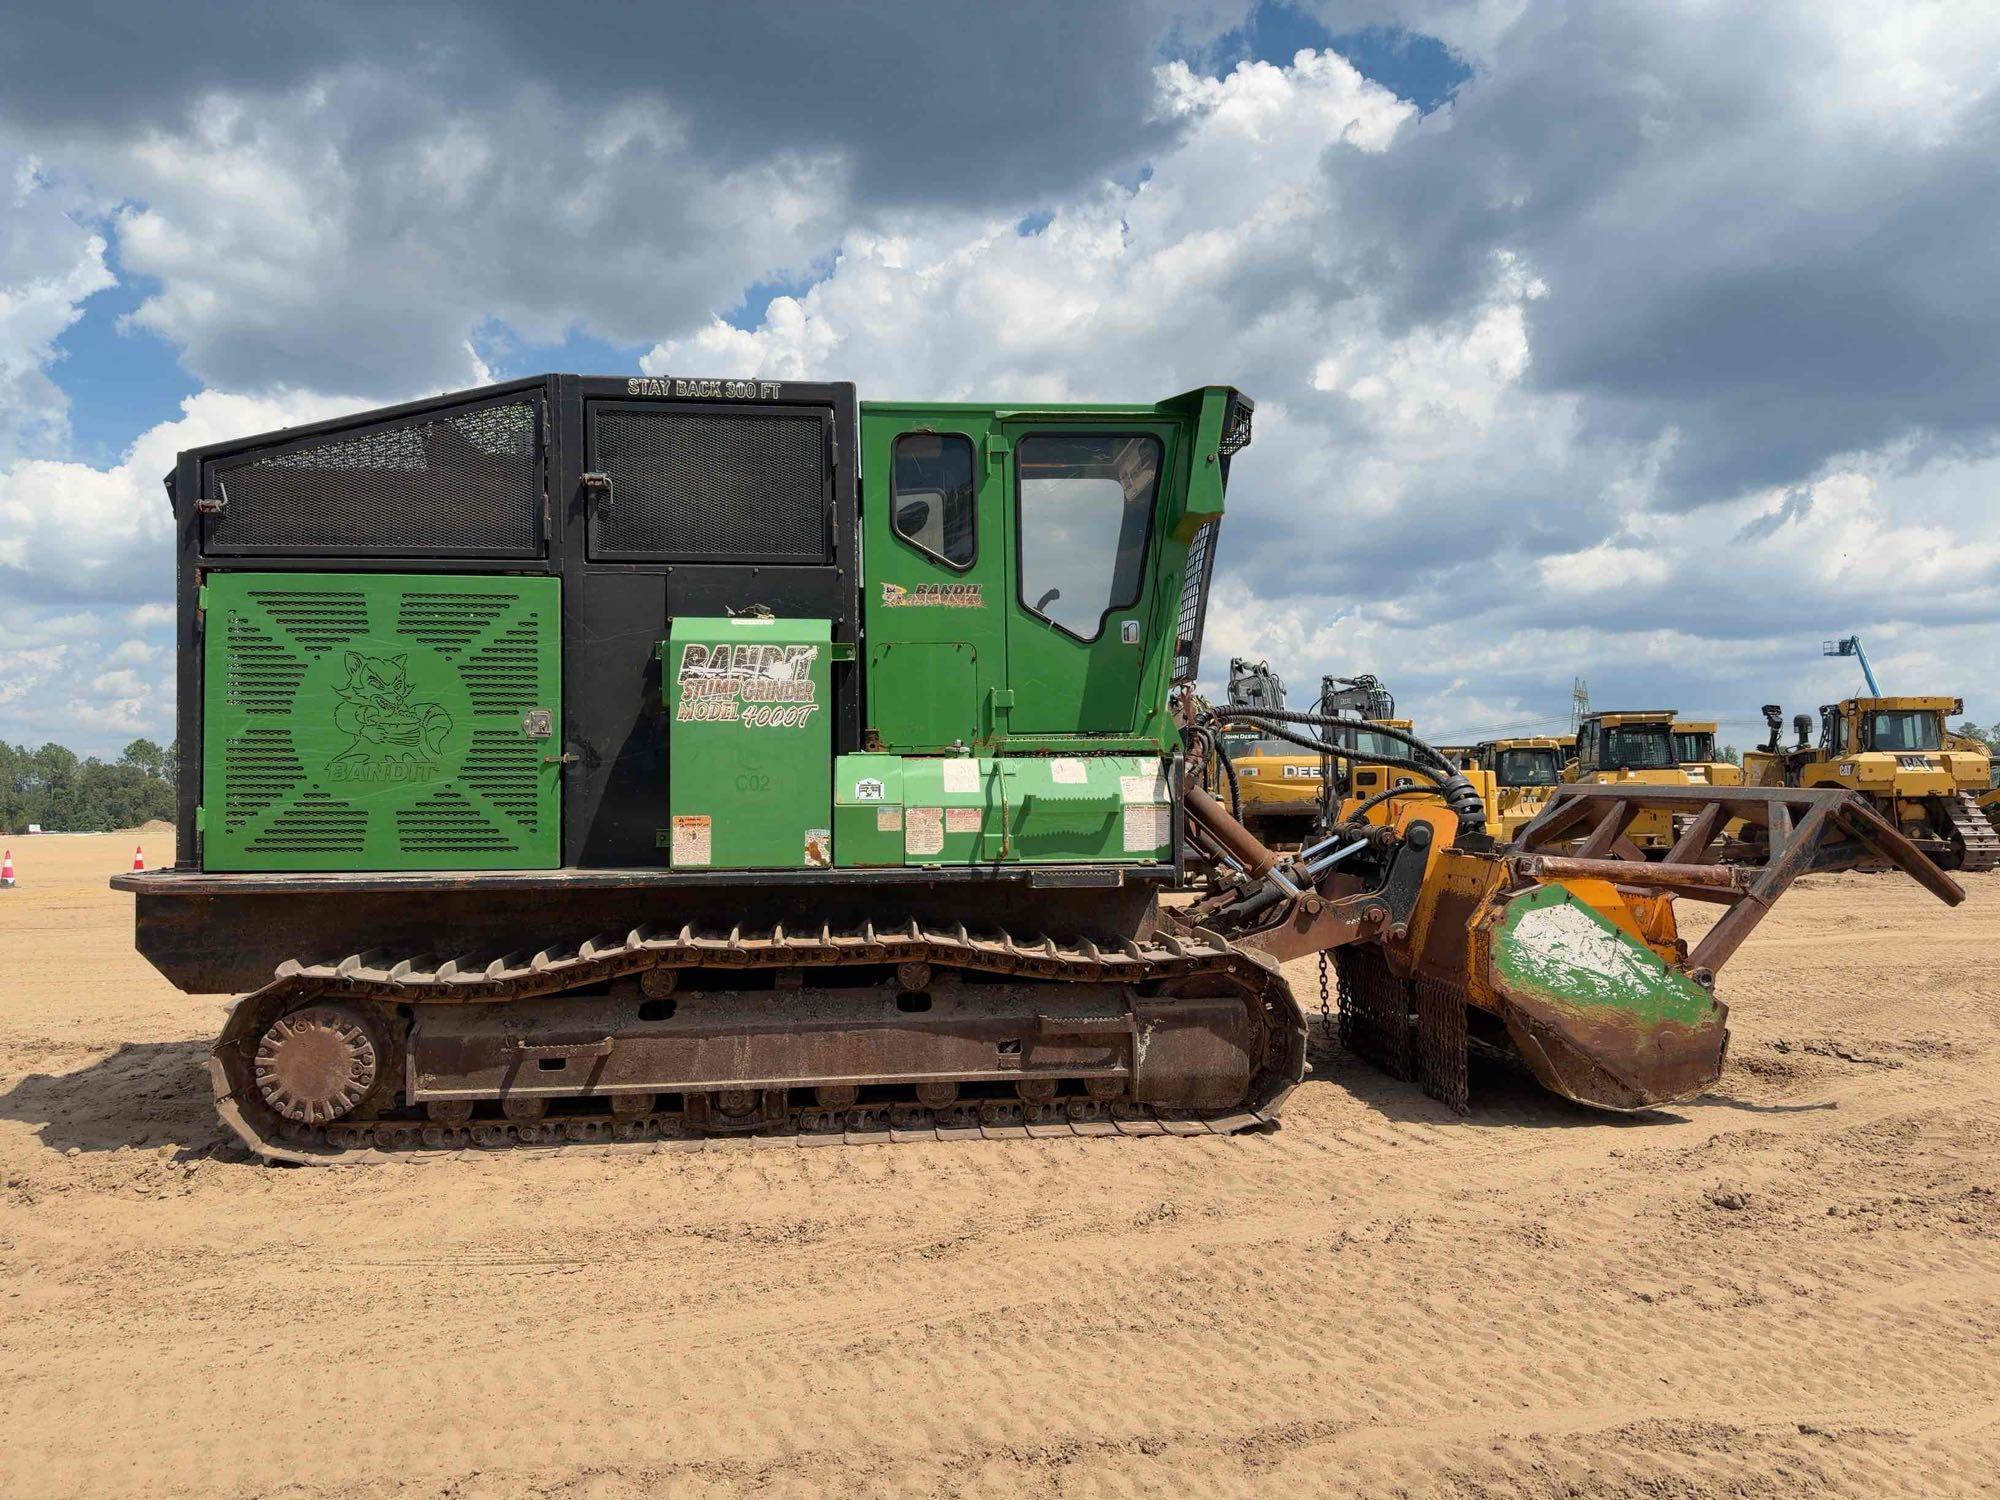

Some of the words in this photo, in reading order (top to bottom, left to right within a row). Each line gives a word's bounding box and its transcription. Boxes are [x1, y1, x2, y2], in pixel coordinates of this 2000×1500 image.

[627, 378, 670, 395] STAY
[676, 380, 722, 397] BACK
[726, 382, 757, 399] 300
[760, 383, 782, 399] FT
[681, 678, 742, 702] STUMP
[677, 701, 739, 722] MODEL
[741, 704, 819, 728] 4000T
[328, 761, 444, 782] BANDIT
[1282, 764, 1322, 779] DEE
[1839, 764, 1852, 776] CAT
[1901, 756, 1935, 772] CAT
